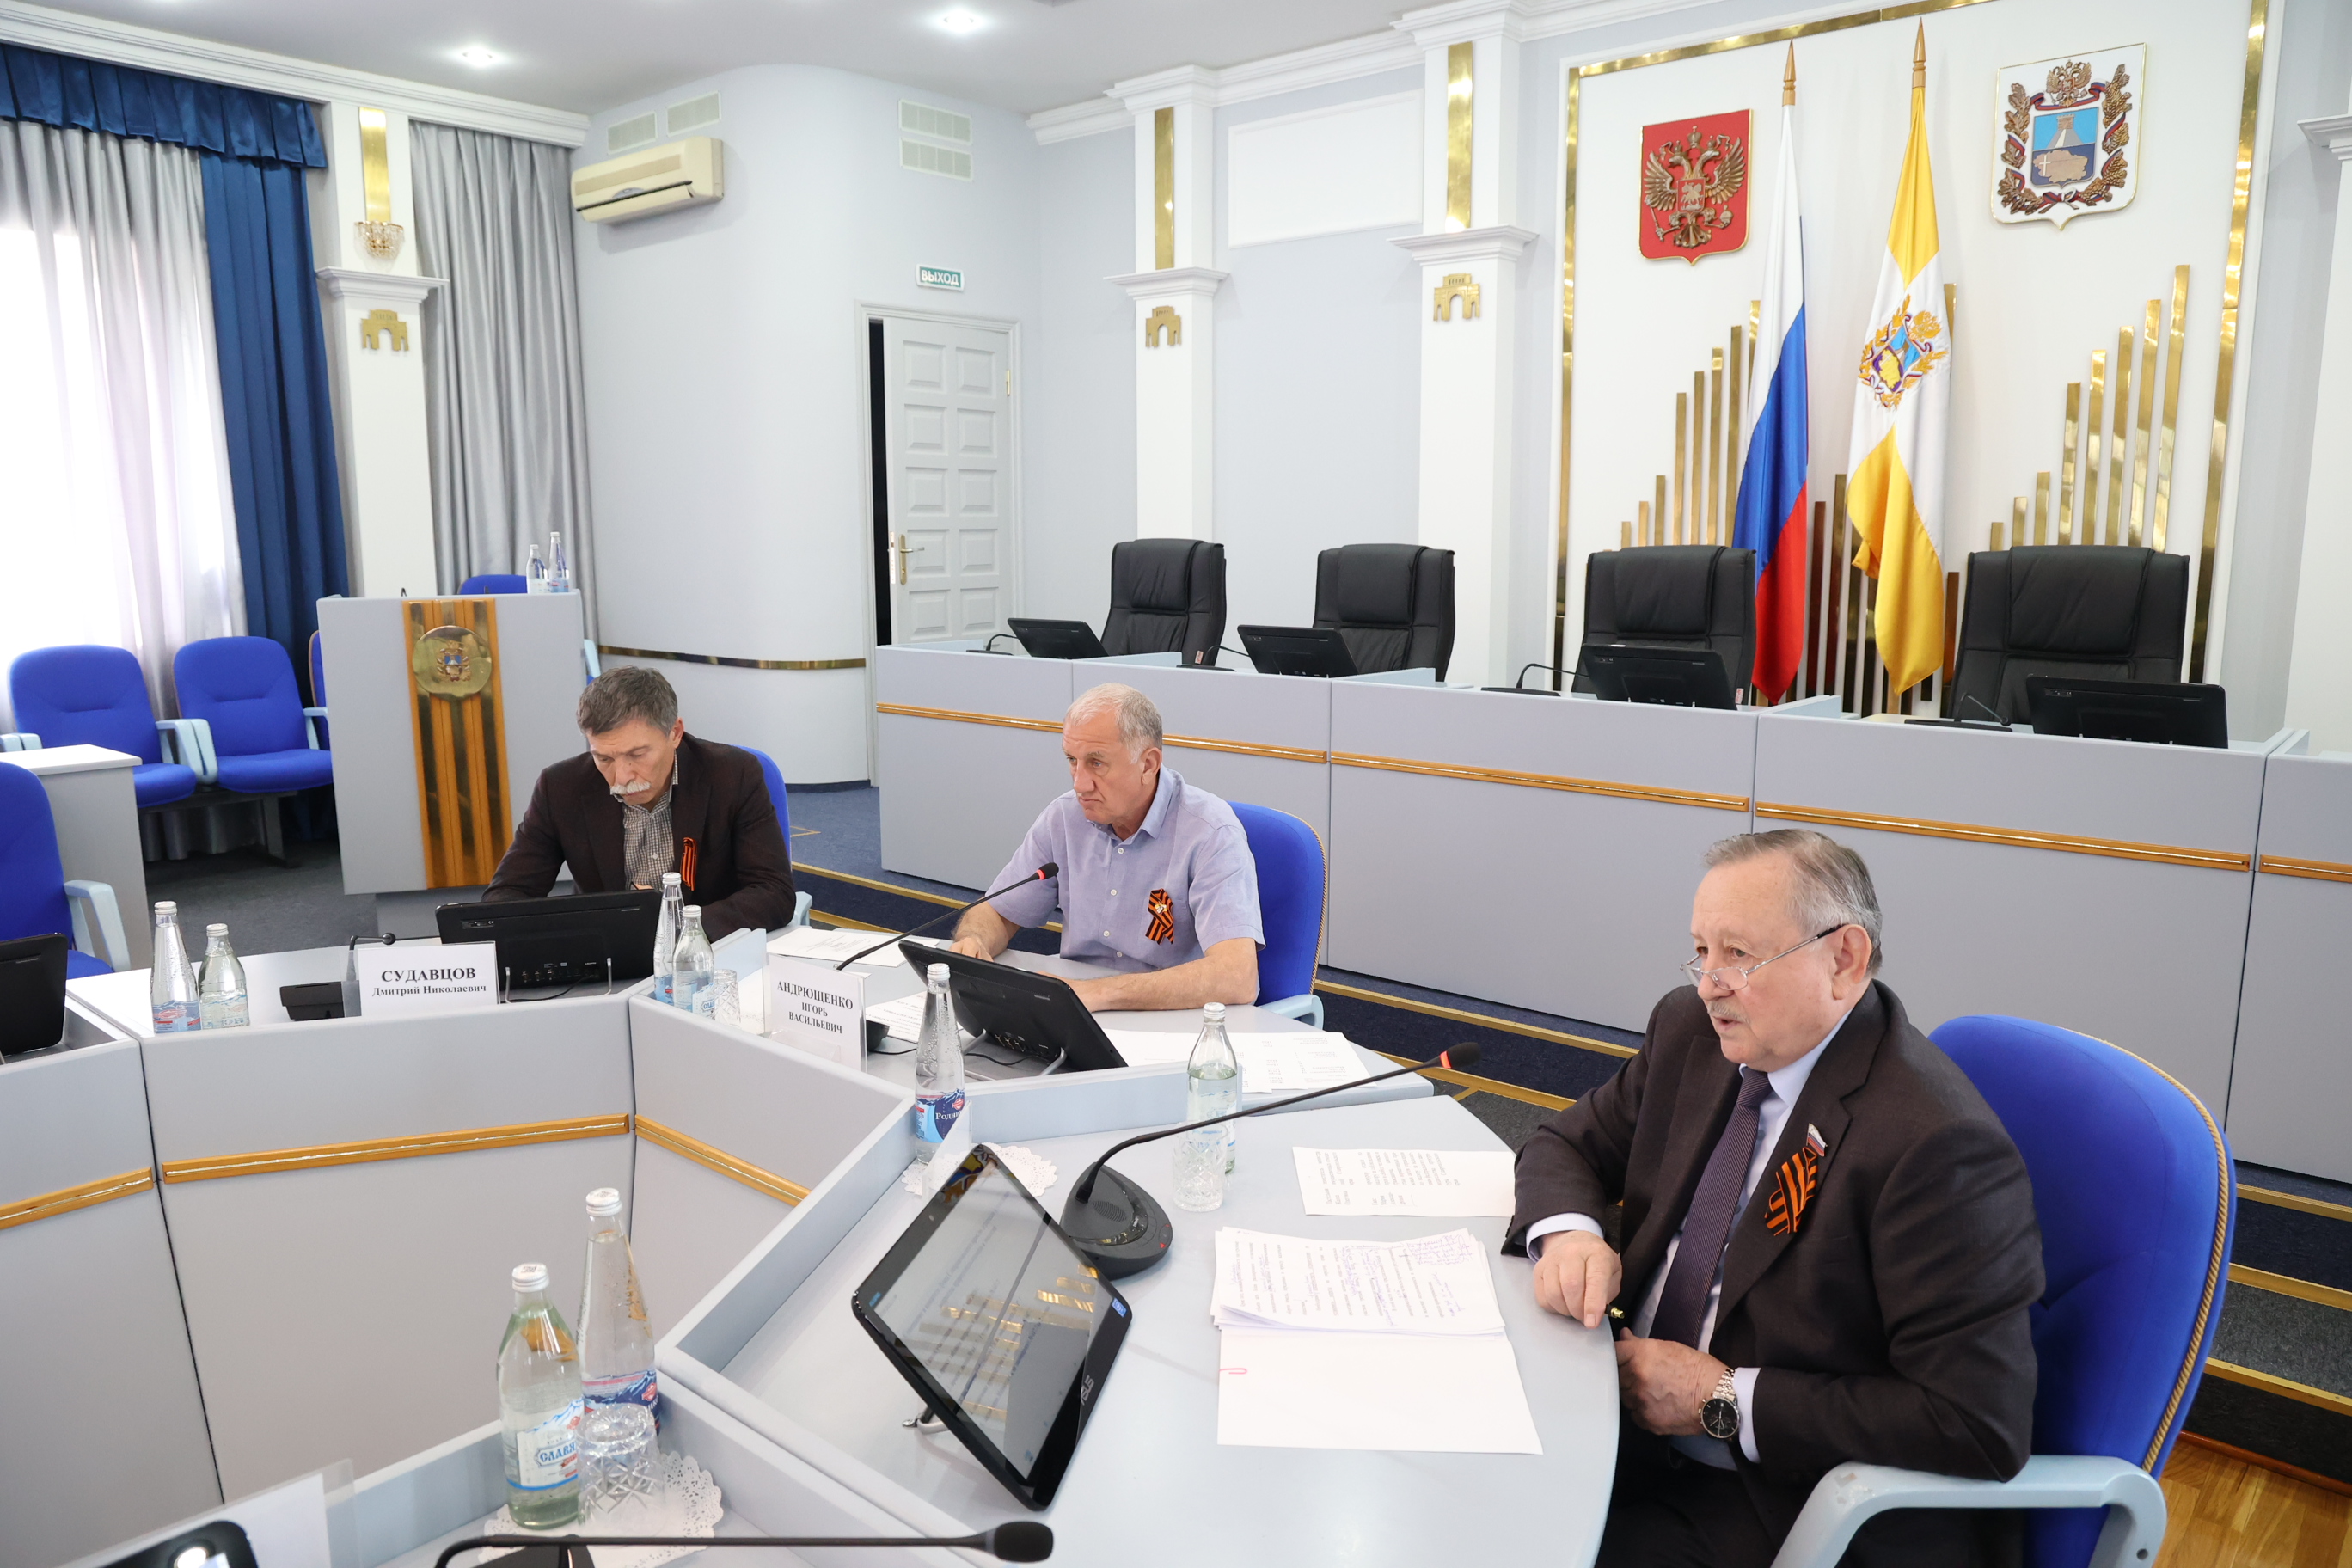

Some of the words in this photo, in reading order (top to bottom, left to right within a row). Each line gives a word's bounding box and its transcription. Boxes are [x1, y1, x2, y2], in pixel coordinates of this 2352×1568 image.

[921, 269, 959, 286] ВЫХОД
[381, 967, 476, 983] СУДАВЦОВ
[372, 986, 420, 997] Дмитрий
[423, 984, 487, 995] Николаевич
[776, 980, 854, 1010] АНДРЮЩЕНКО
[801, 1001, 828, 1017] ИГОРЬ
[788, 1011, 843, 1034] ВАСИЛЬЕВИЧ
